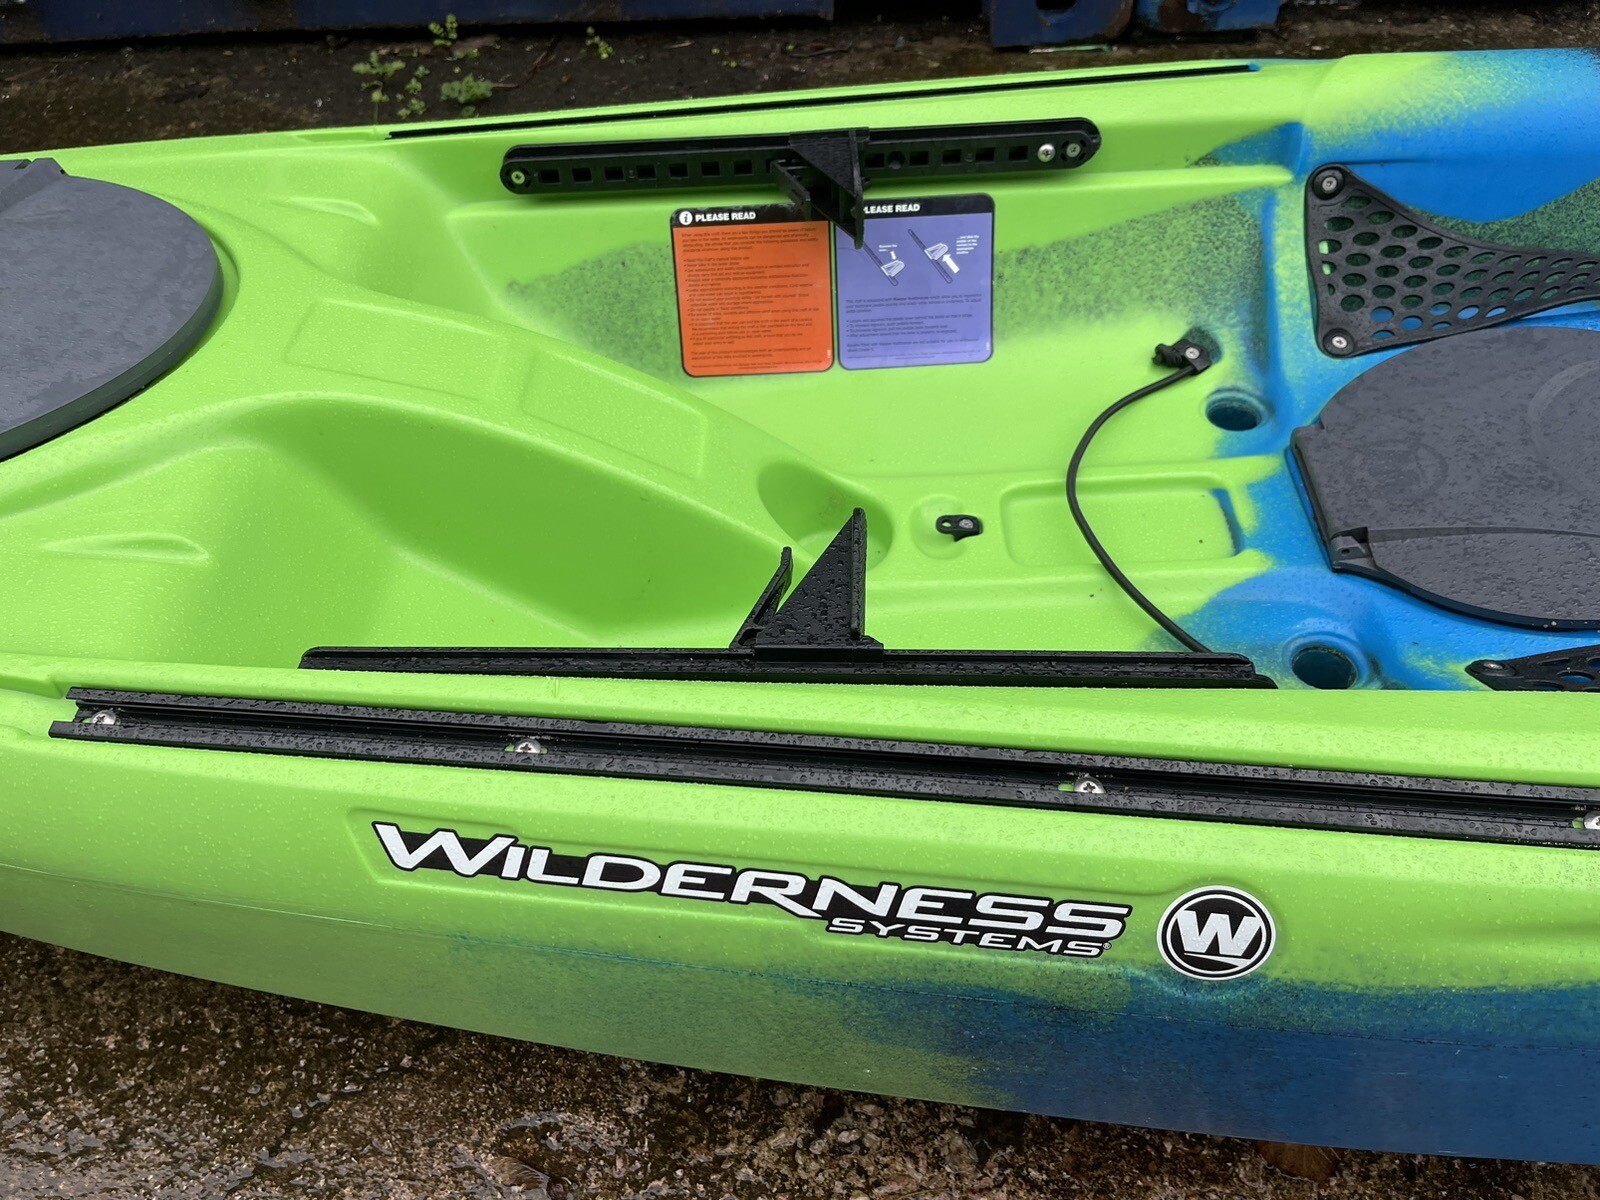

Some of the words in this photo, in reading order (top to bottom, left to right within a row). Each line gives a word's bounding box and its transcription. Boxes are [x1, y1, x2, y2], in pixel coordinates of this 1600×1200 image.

[863, 205, 893, 214] LEASE
[895, 203, 920, 212] READ
[695, 212, 730, 222] PLEASE
[731, 211, 756, 220] READ
[374, 823, 1129, 938] WILDERNESS
